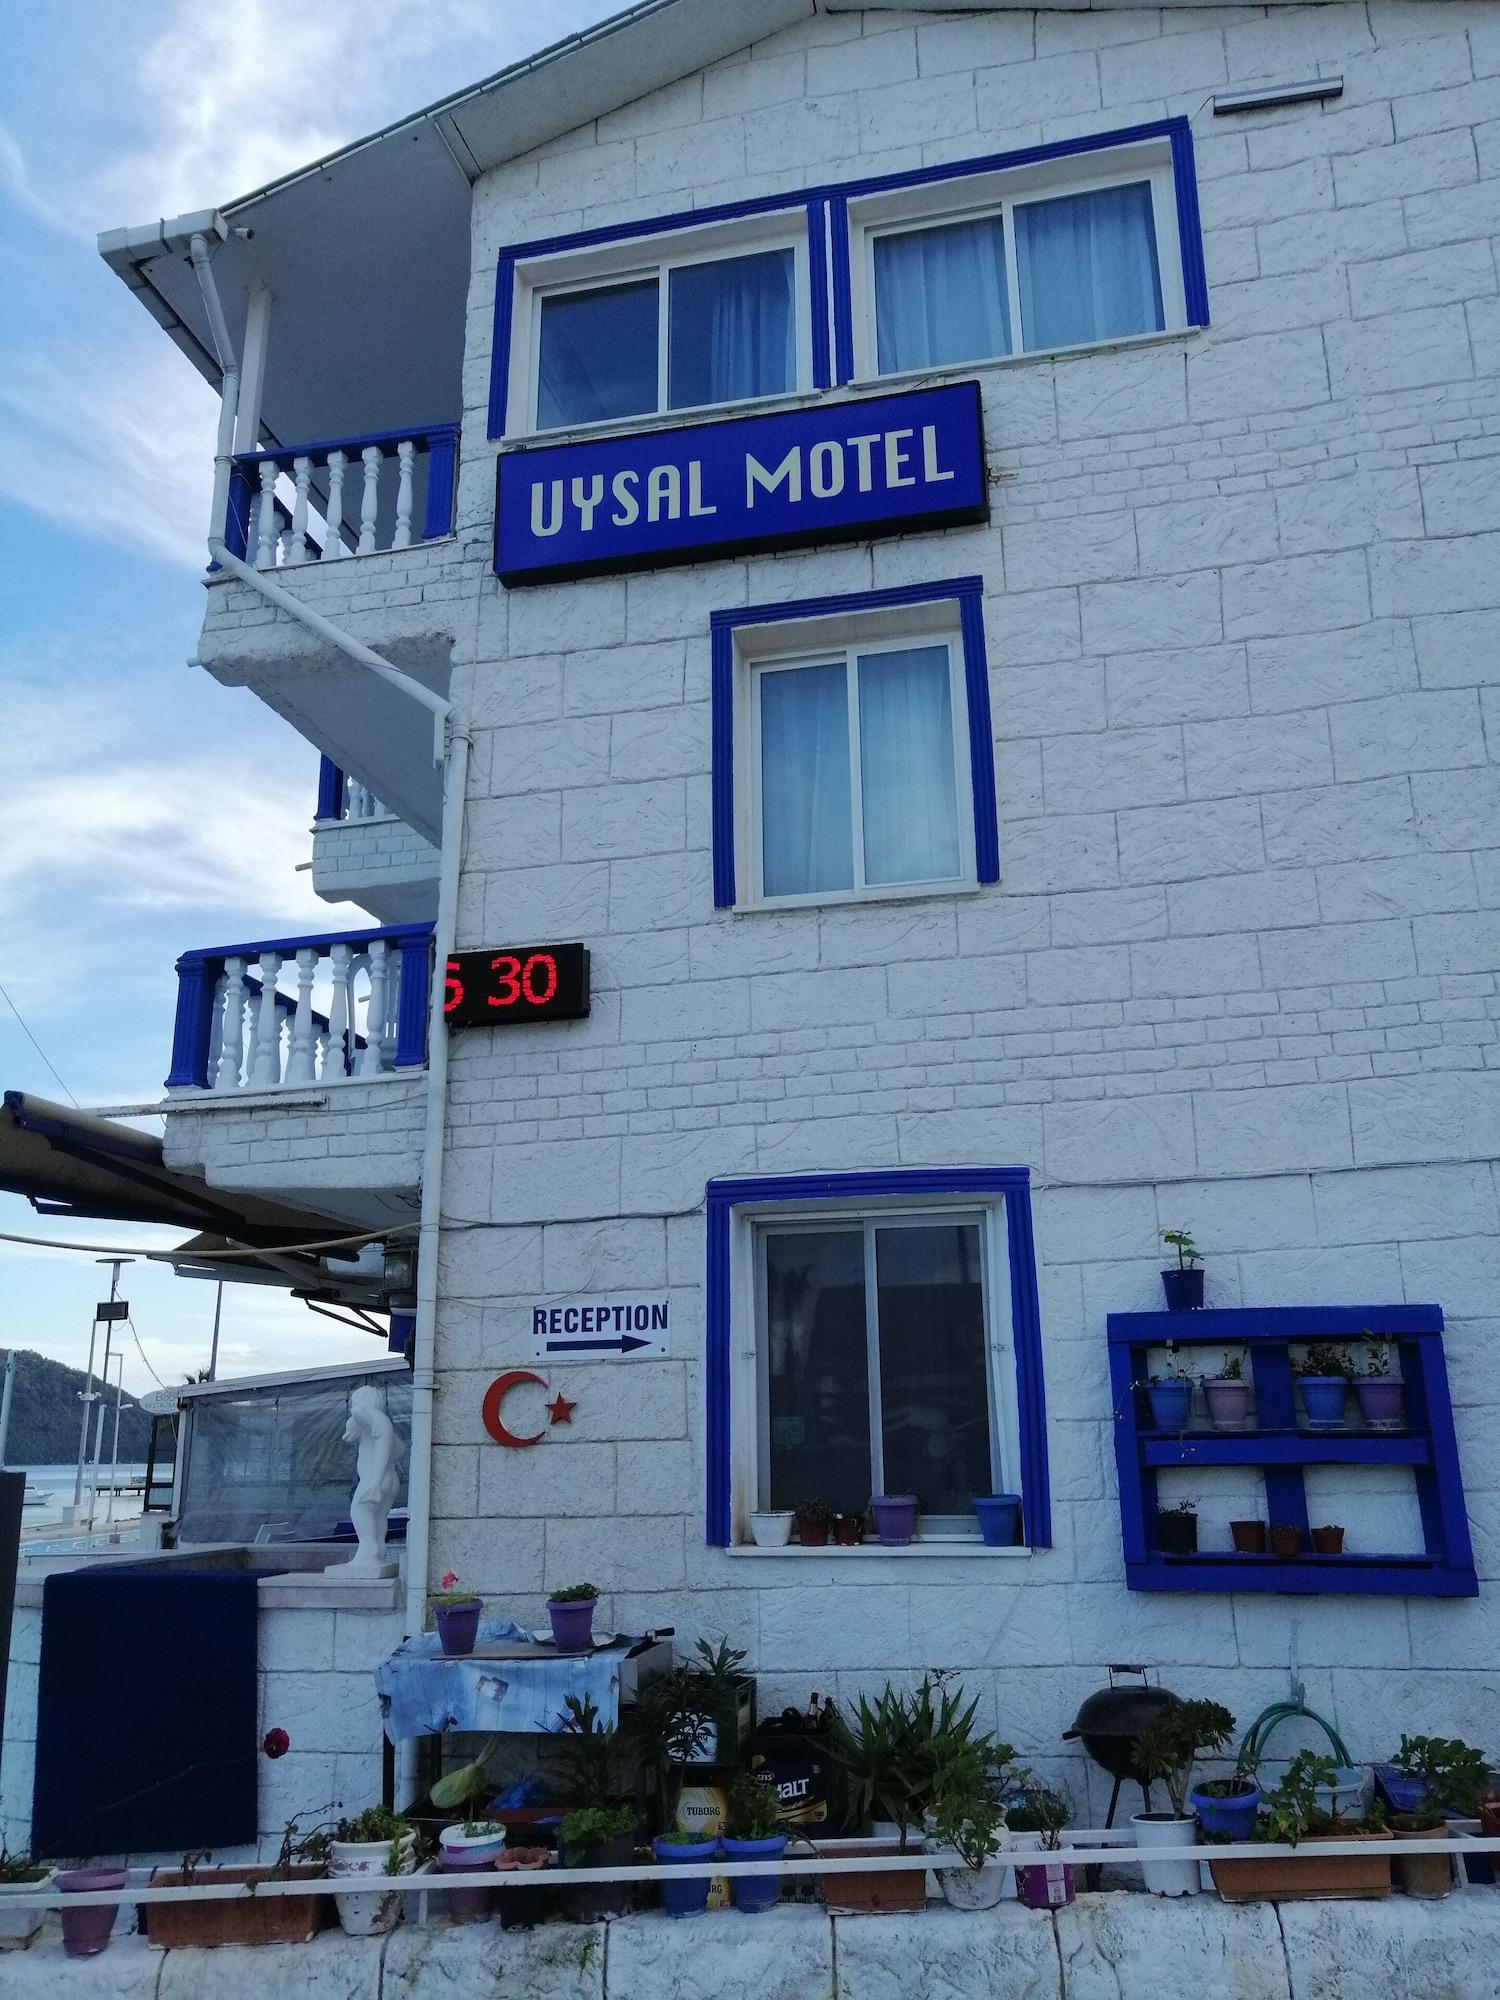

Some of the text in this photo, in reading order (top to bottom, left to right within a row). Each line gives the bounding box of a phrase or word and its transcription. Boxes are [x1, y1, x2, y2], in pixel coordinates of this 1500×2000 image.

[530, 425, 955, 537] UYSAL MOTEL
[487, 953, 557, 1007] 30
[533, 1304, 668, 1334] RECEPTION
[687, 1806, 721, 1816] TUBORG
